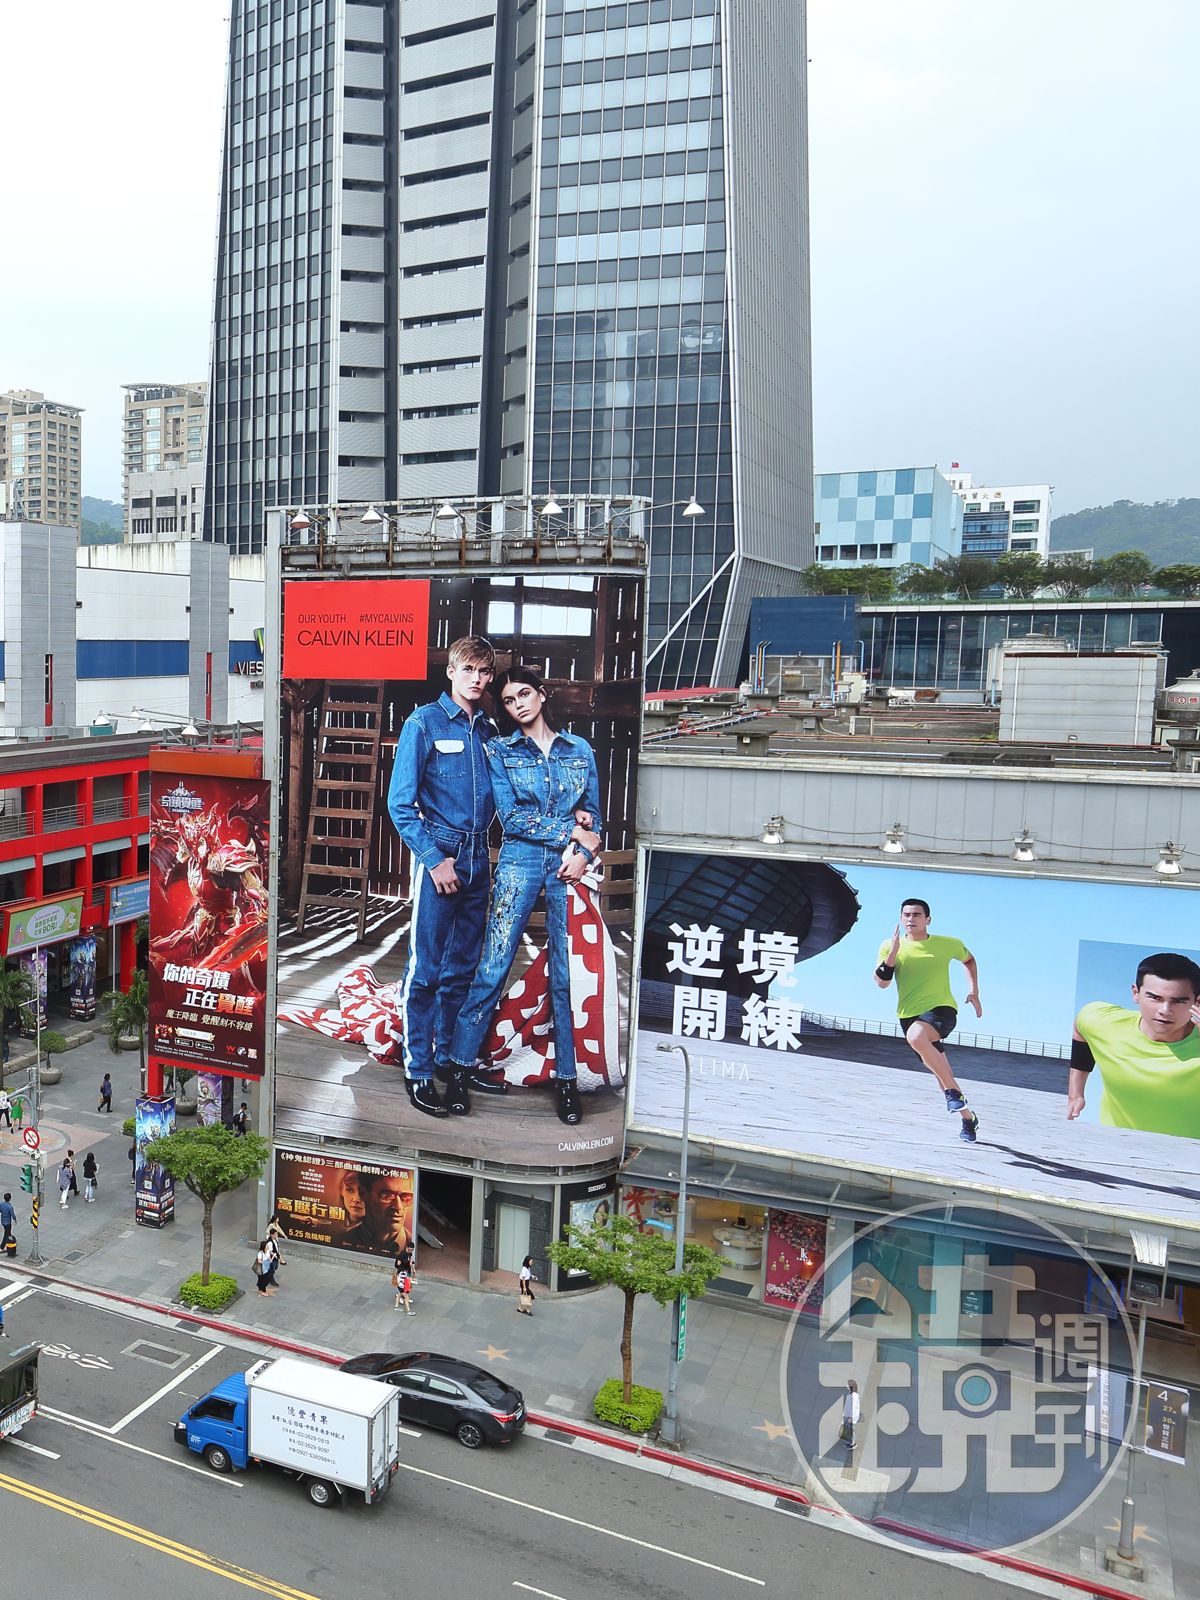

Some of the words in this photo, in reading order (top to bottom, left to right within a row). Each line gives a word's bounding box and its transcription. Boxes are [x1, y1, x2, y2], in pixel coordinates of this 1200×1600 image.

[298, 614, 316, 624] OUR
[359, 613, 414, 624] #MYCALVINS
[297, 630, 360, 646] CALVIN
[365, 630, 413, 646] KLEIN
[665, 922, 800, 988] 逆境
[163, 963, 231, 990] 你的奇蹟
[182, 987, 257, 1017] 正在覺醒
[672, 984, 803, 1051] 開練
[558, 1136, 614, 1151] CALVINKLEIN.COM
[277, 1197, 346, 1221] 高壓行動
[288, 1229, 304, 1238] 5.25
